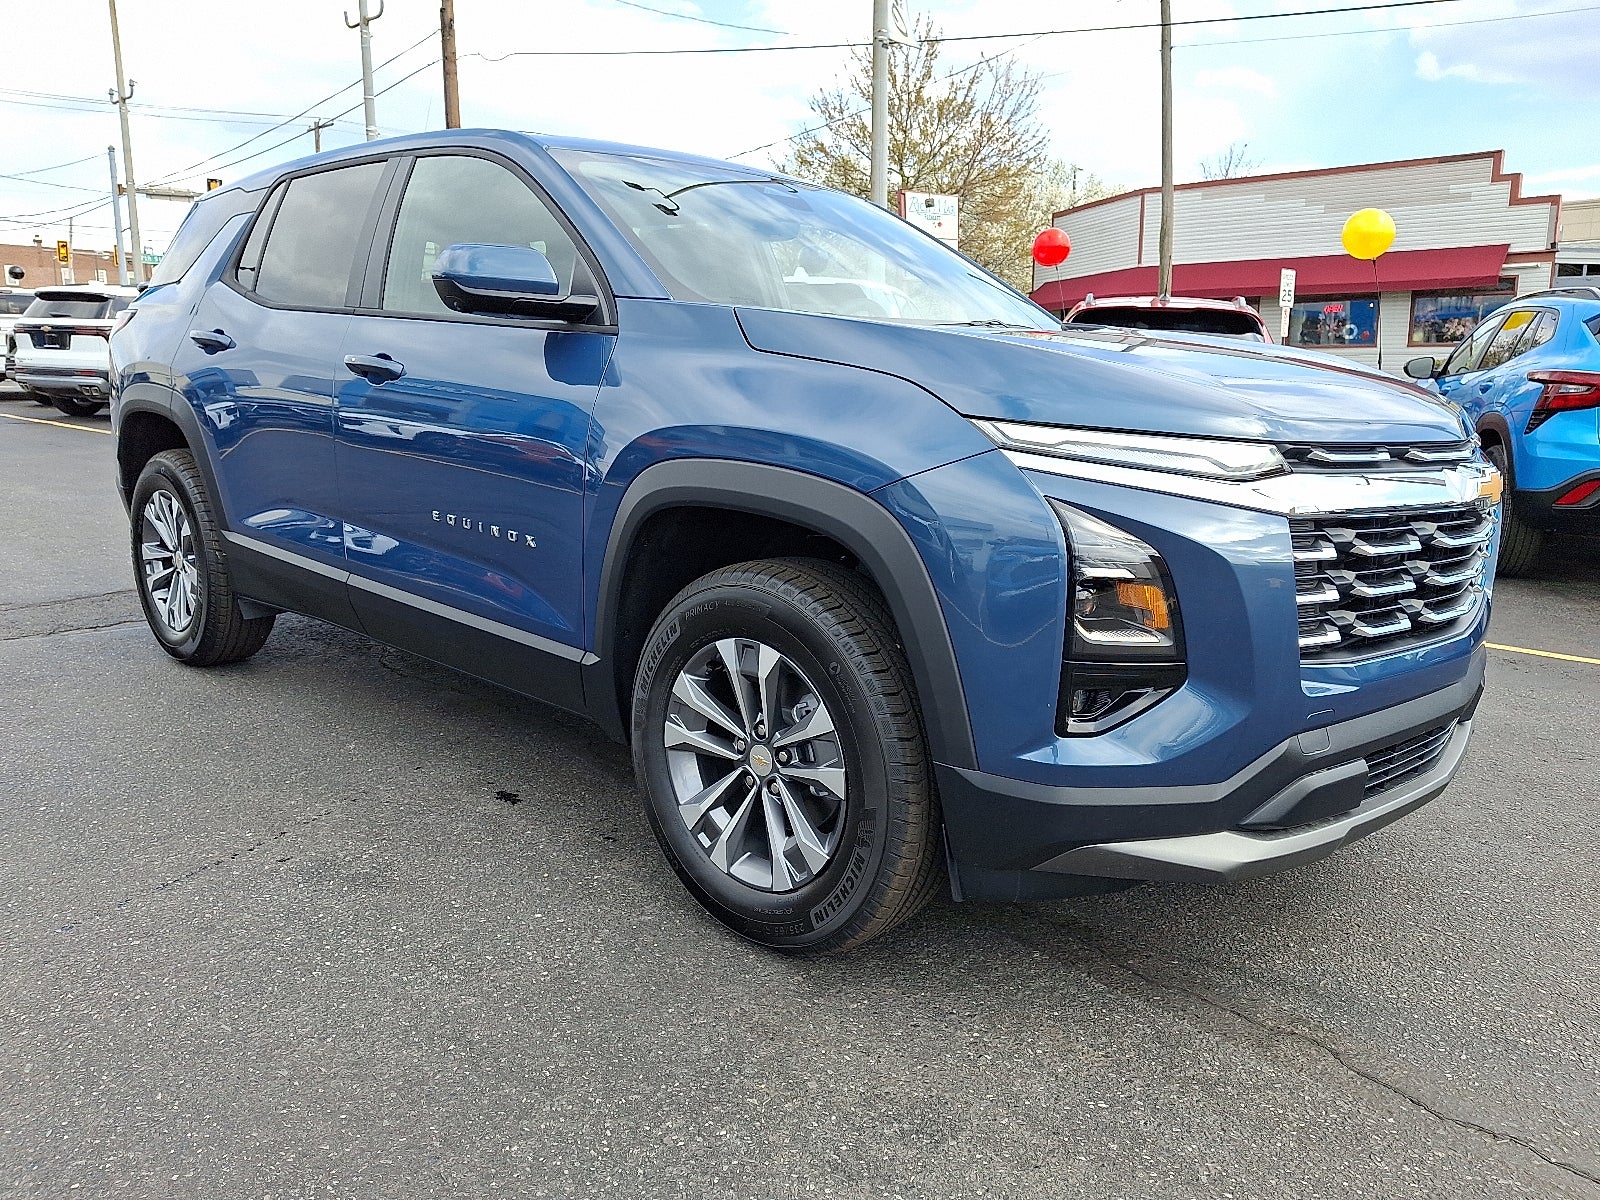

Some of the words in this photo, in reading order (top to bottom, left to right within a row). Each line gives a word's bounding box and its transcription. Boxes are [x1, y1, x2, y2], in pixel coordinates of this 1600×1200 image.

[1281, 289, 1292, 303] 25
[431, 510, 537, 548] EQUINOX
[684, 600, 720, 620] PRIMACY
[639, 621, 679, 697] MICHELIN
[813, 853, 866, 926] MICHELIN
